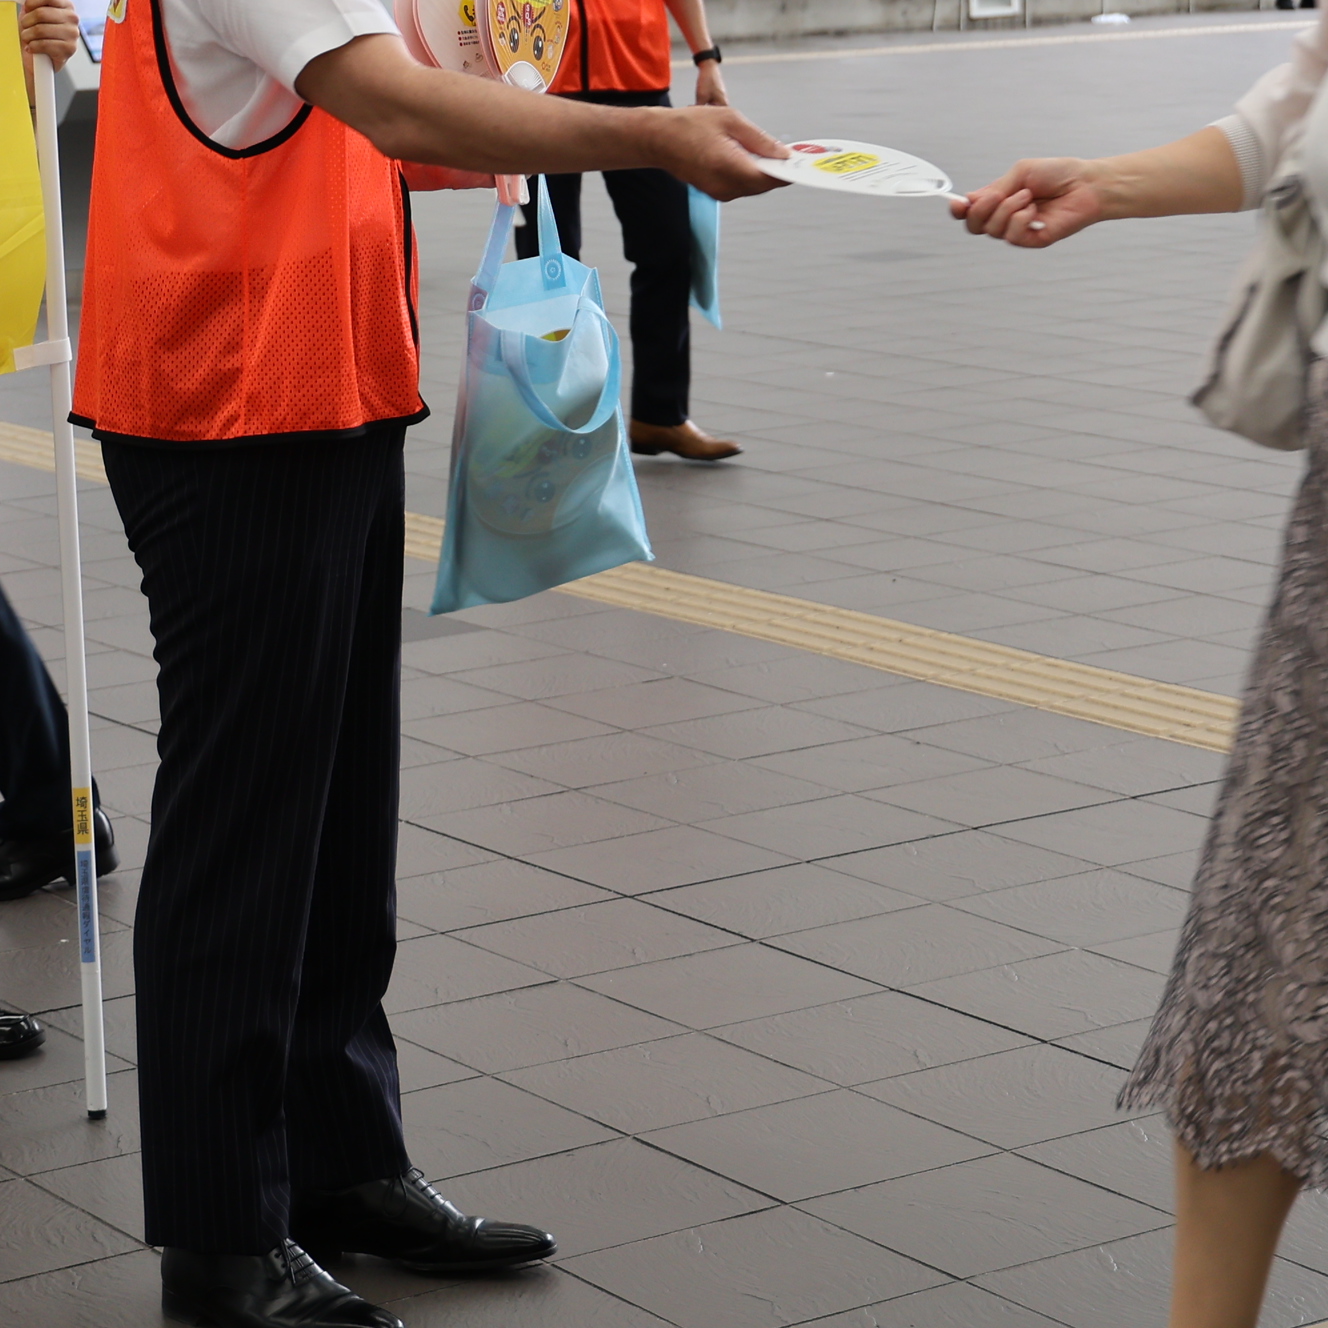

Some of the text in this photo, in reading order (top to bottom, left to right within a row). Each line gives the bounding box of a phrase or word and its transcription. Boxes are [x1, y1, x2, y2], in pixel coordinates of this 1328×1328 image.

[524, 3, 532, 26] SOS
[76, 796, 90, 836] 埼玉県
